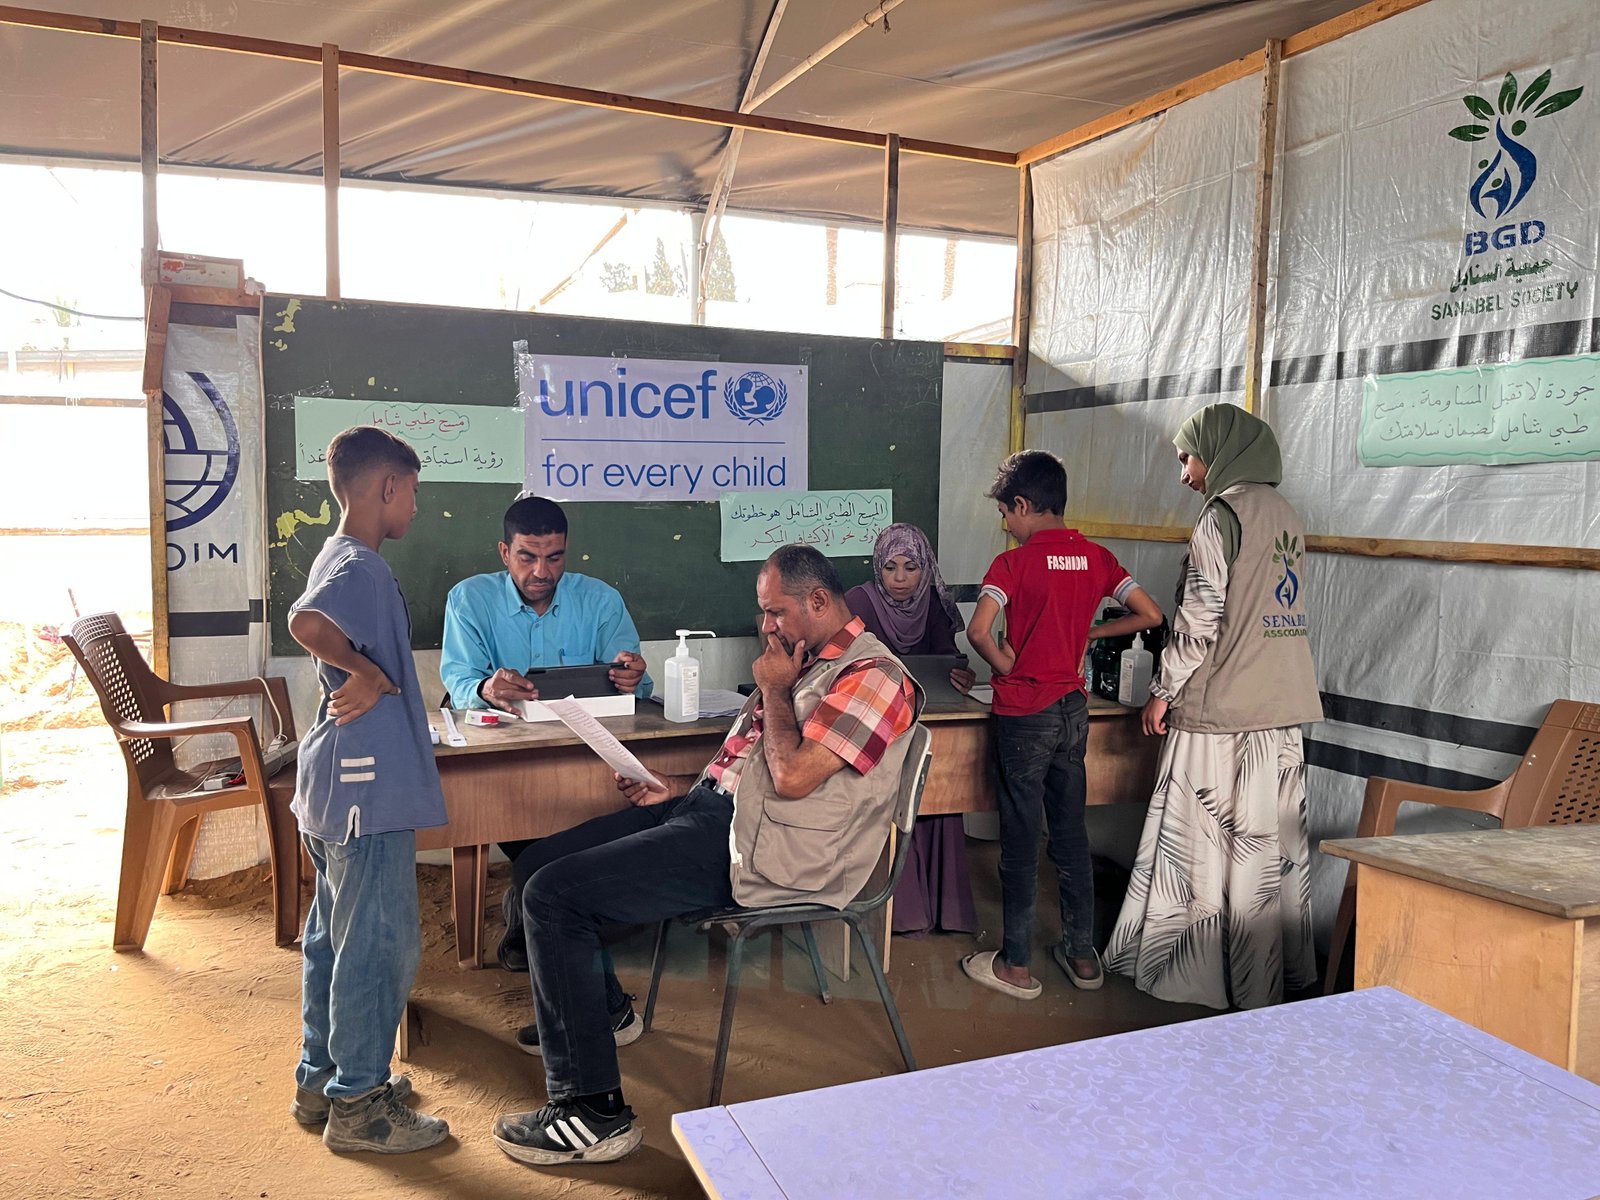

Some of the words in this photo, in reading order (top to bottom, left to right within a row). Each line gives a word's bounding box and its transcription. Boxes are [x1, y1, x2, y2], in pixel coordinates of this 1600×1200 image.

[1465, 219, 1546, 256] BGD
[1450, 262, 1503, 293] السنابل
[1505, 257, 1553, 284] جمعية
[1431, 294, 1504, 321] SANABEL
[1510, 280, 1579, 308] SOCIETY
[539, 367, 718, 420] unicef
[405, 411, 435, 430] طبي
[438, 418, 465, 433] مسح
[1501, 412, 1542, 442] شامل
[1549, 413, 1589, 446] طبي
[420, 446, 468, 468] استباقي
[473, 448, 504, 469] رؤية
[542, 453, 594, 487] for
[603, 463, 704, 494] every
[712, 456, 786, 487] child
[731, 504, 767, 522] خطوتك
[766, 509, 780, 521] هو
[786, 502, 823, 520] الشامل
[825, 502, 856, 525] الطبي
[858, 502, 884, 525] المسح
[1046, 555, 1088, 571] FASHION
